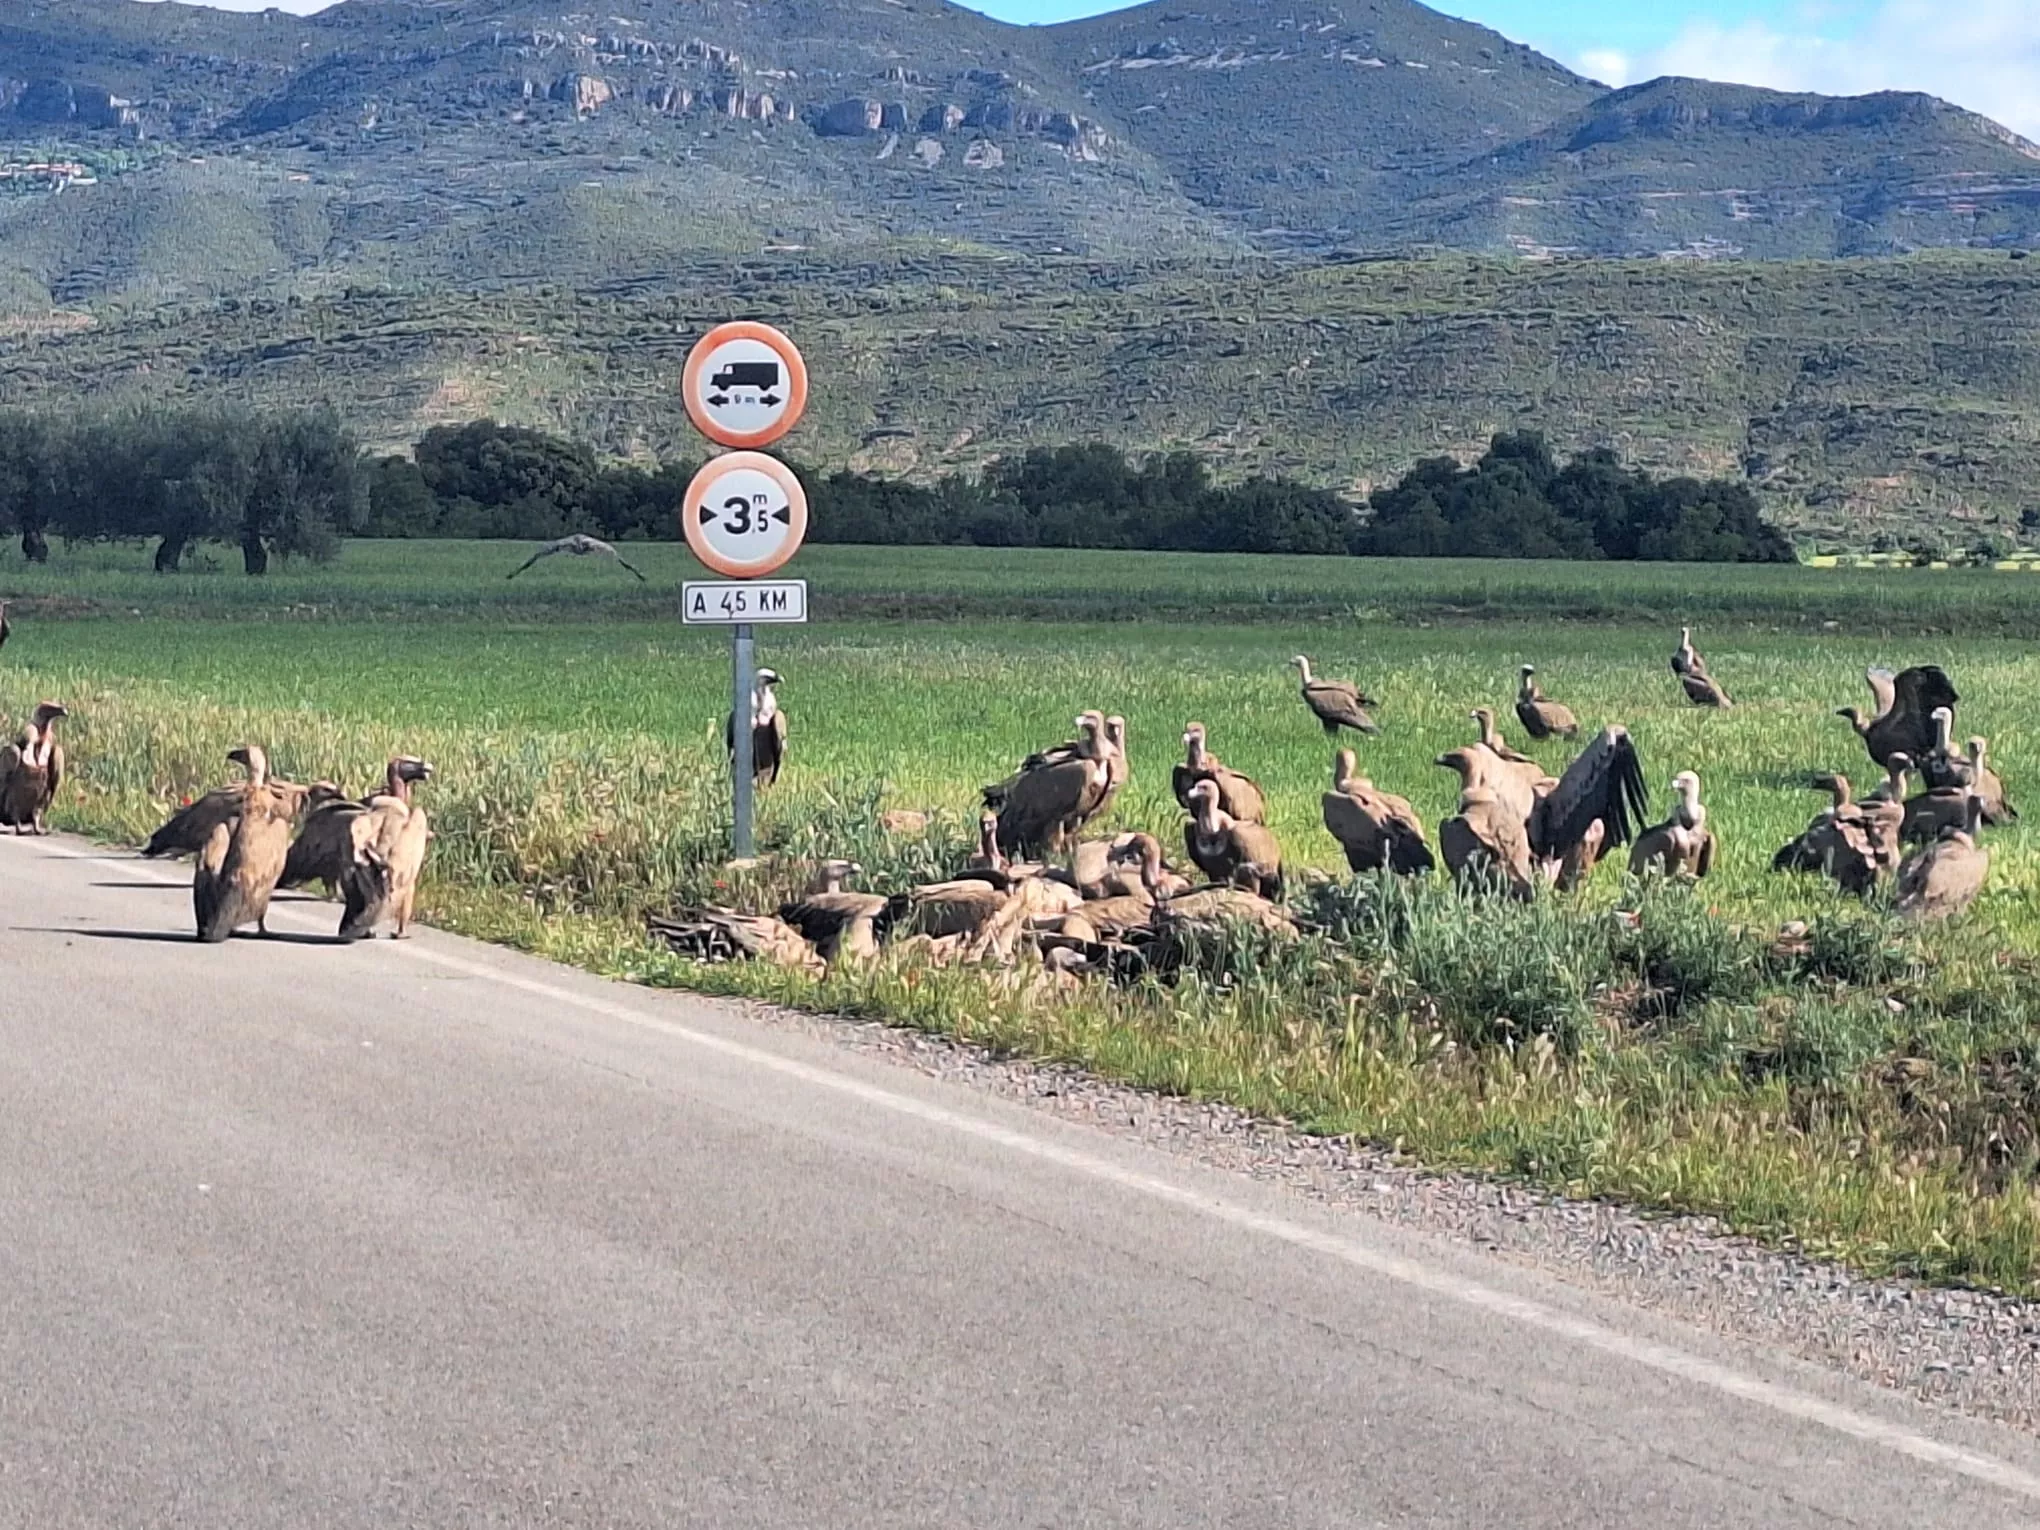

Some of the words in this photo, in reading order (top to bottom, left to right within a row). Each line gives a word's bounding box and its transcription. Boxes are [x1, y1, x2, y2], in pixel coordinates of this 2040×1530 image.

[753, 494, 767, 504] m
[693, 591, 706, 613] A
[759, 589, 787, 612] KM
